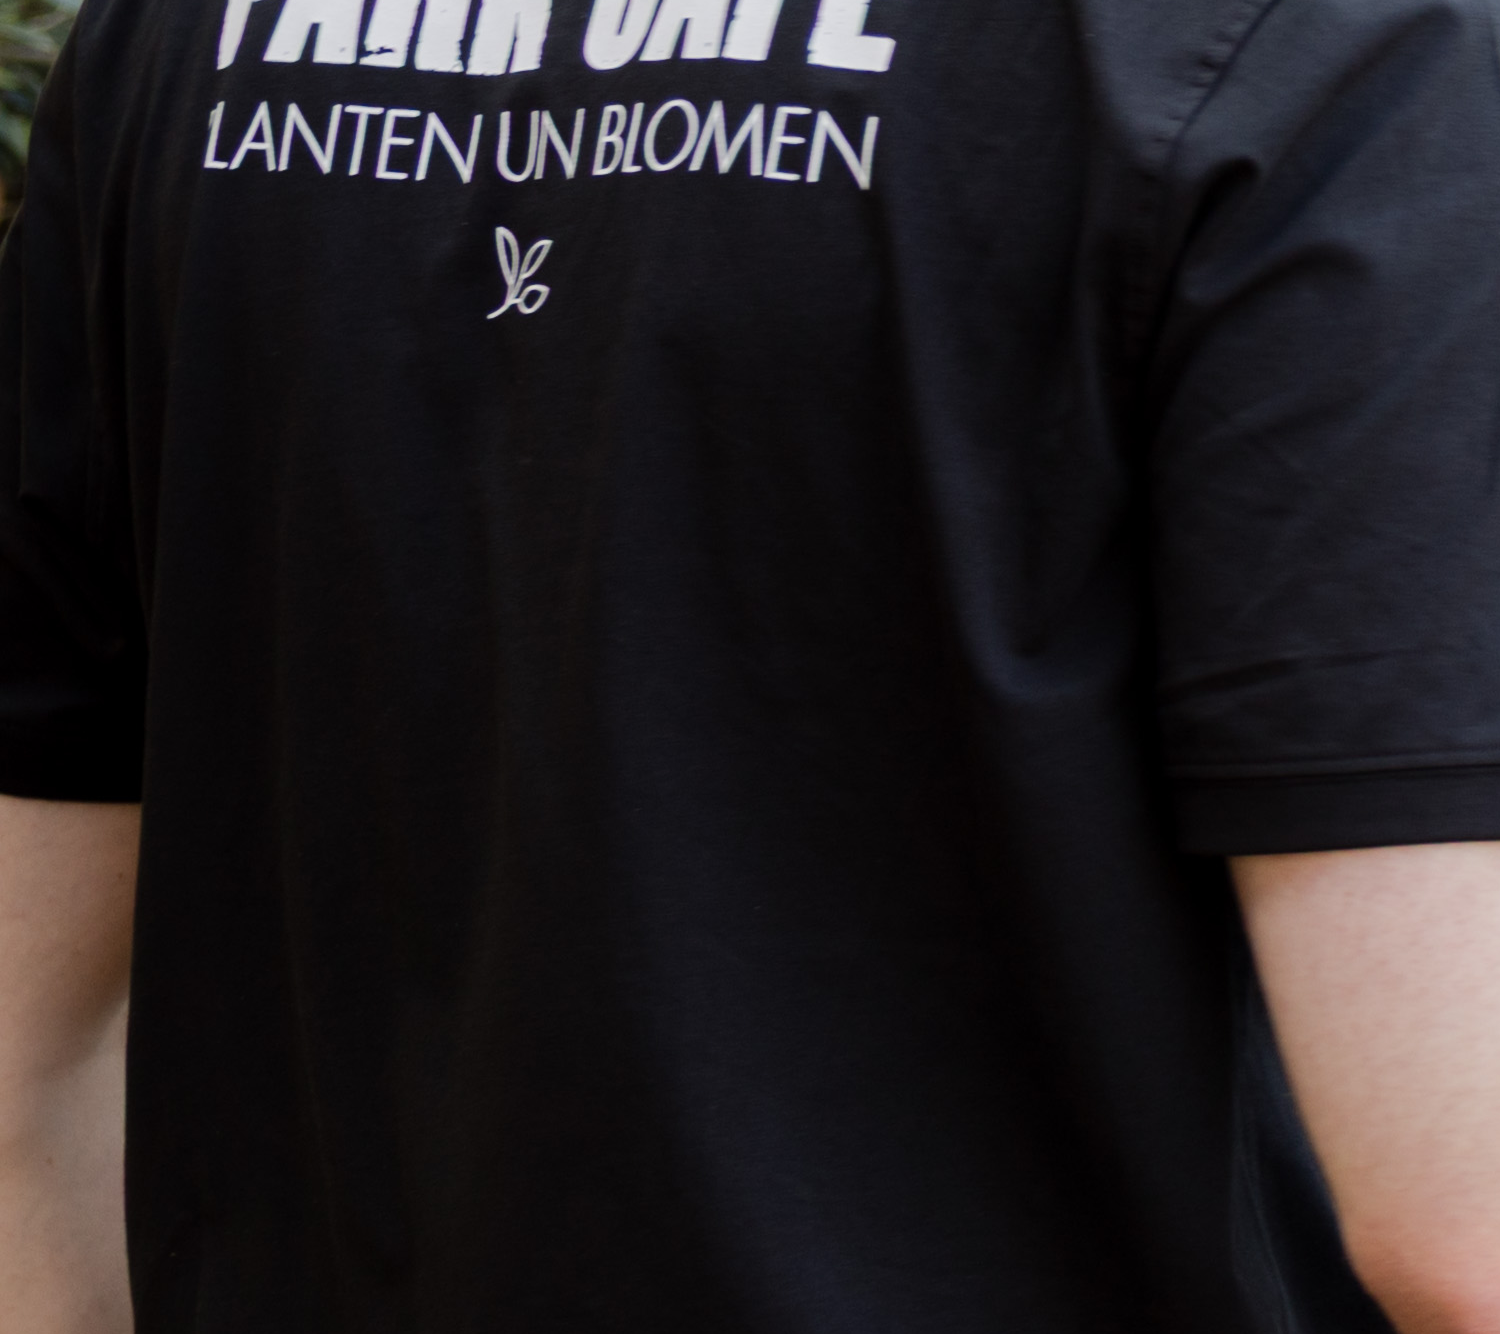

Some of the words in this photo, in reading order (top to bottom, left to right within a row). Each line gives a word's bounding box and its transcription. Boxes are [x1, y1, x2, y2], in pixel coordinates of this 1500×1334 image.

[203, 100, 483, 184] LANTEN
[495, 107, 587, 183] UN
[592, 98, 880, 190] BLOMEN
